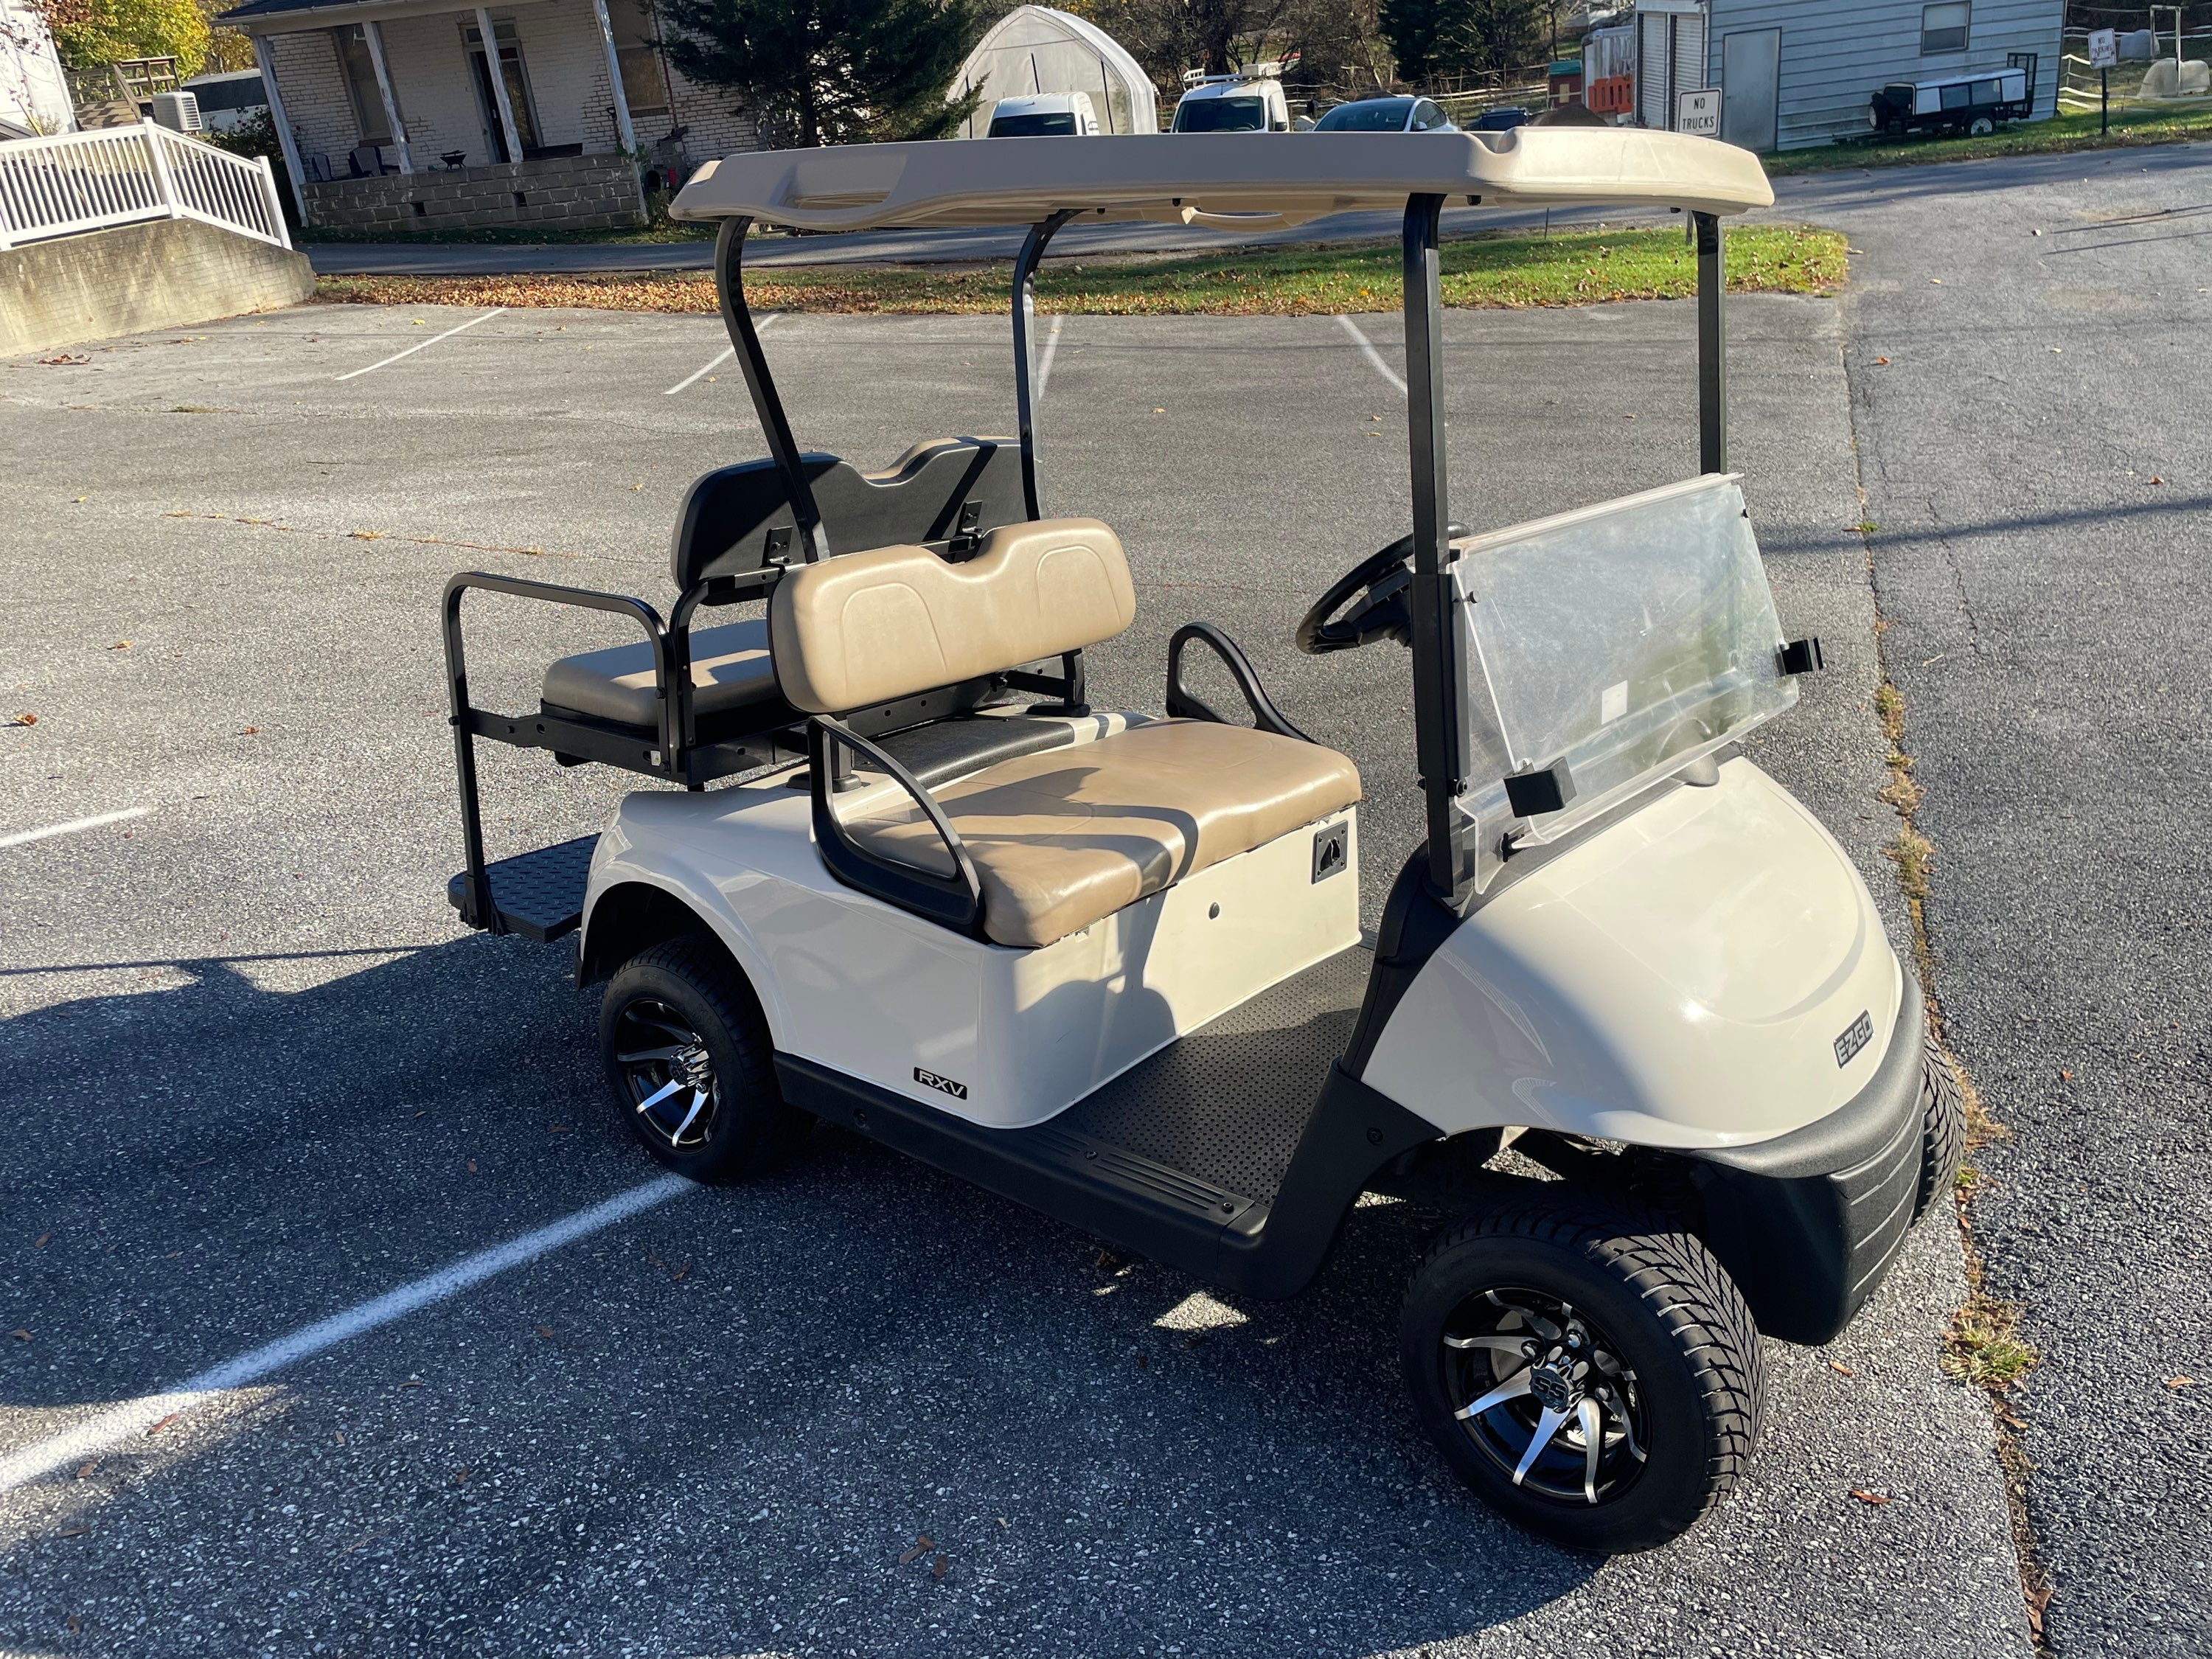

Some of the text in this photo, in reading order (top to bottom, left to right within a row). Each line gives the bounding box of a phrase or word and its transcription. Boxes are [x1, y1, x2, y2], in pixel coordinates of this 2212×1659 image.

[1694, 97, 1705, 110] NO
[1683, 116, 1714, 130] TRUCKS
[919, 1070, 964, 1096] RXV
